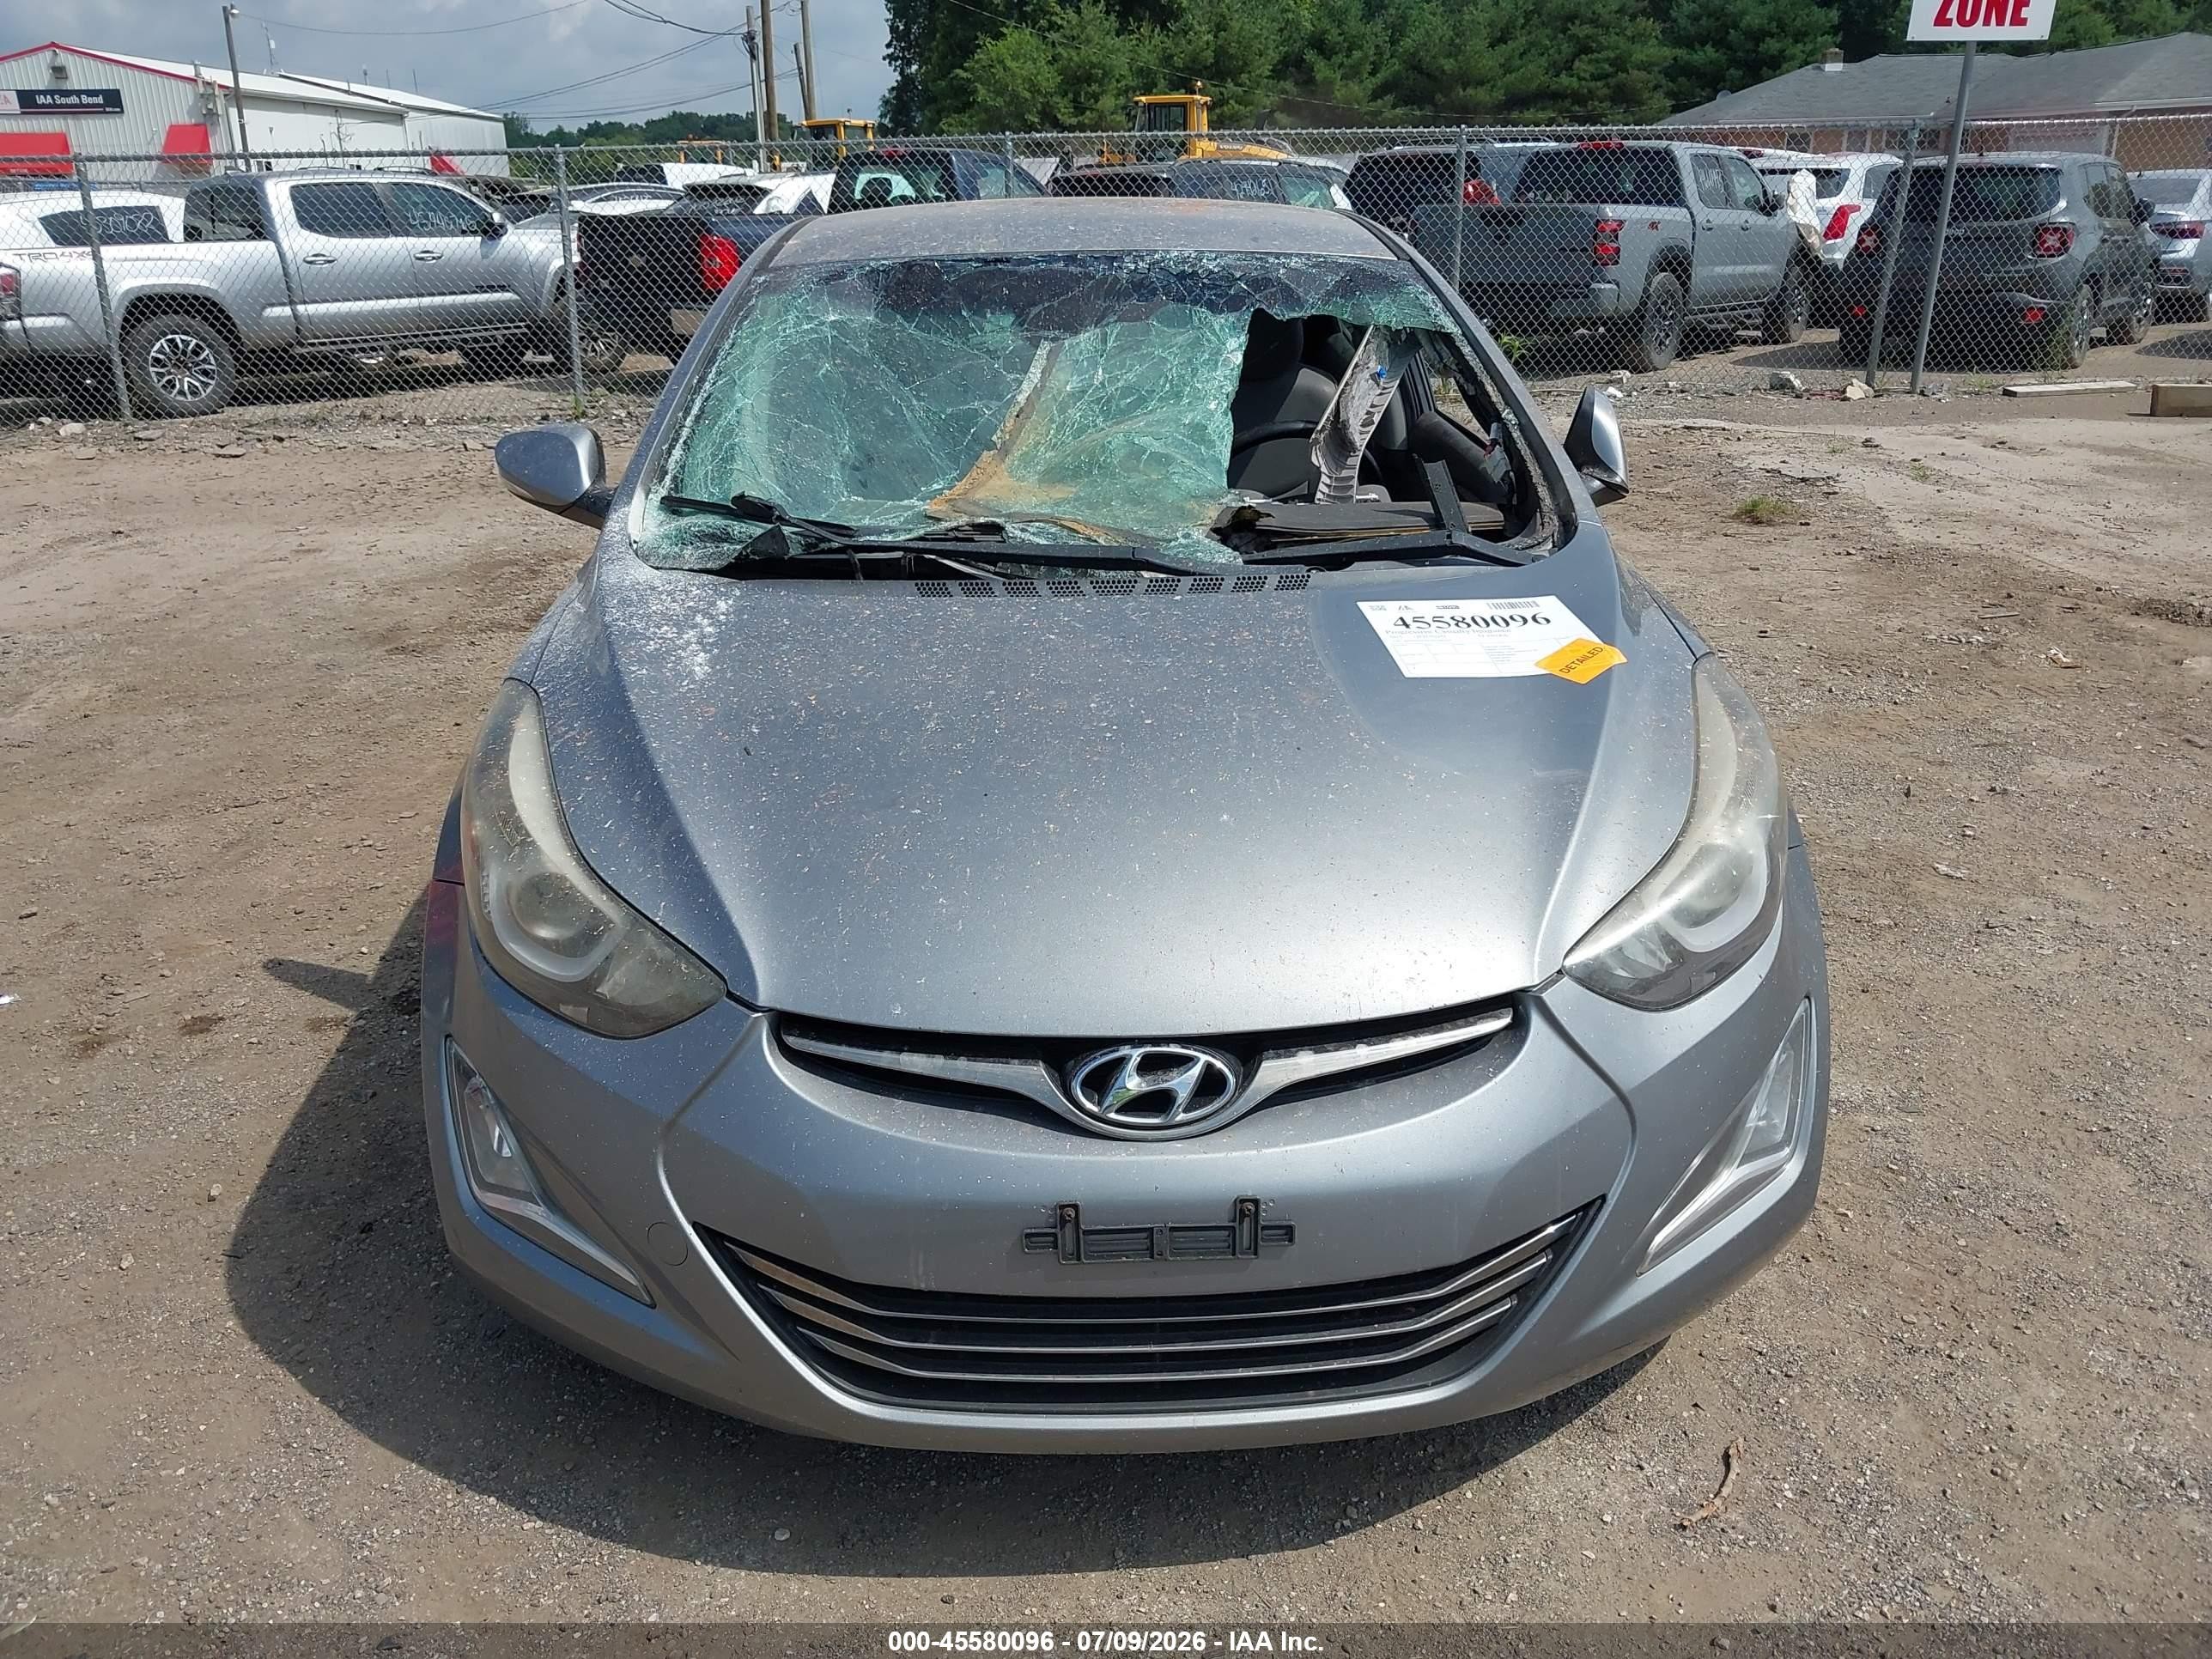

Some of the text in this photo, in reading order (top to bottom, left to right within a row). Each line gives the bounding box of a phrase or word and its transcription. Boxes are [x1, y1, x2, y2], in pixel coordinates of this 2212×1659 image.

[1933, 0, 2031, 27] ZONE
[35, 94, 104, 105] IAA South Bend
[1393, 611, 1552, 629] 45580096
[1559, 647, 1604, 674] DETAILED
